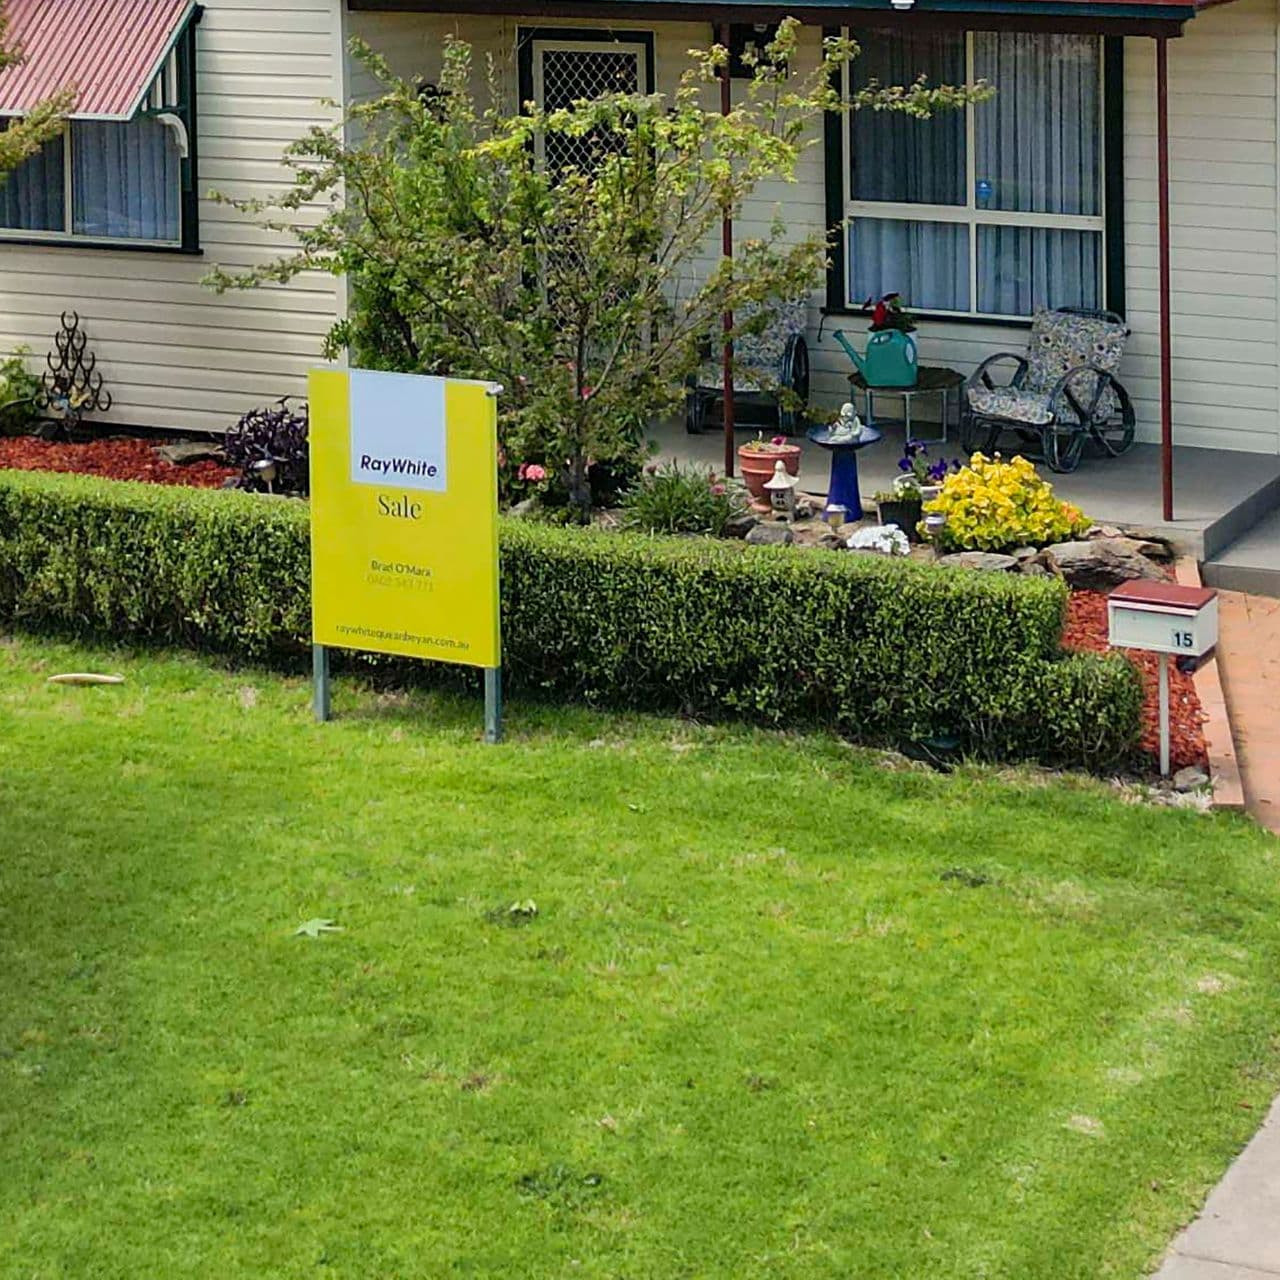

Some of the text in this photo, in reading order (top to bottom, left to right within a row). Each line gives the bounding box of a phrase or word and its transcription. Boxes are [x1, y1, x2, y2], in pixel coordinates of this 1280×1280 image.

[360, 454, 438, 477] RayWhite
[378, 493, 422, 520] Sale
[1174, 631, 1193, 647] 15
